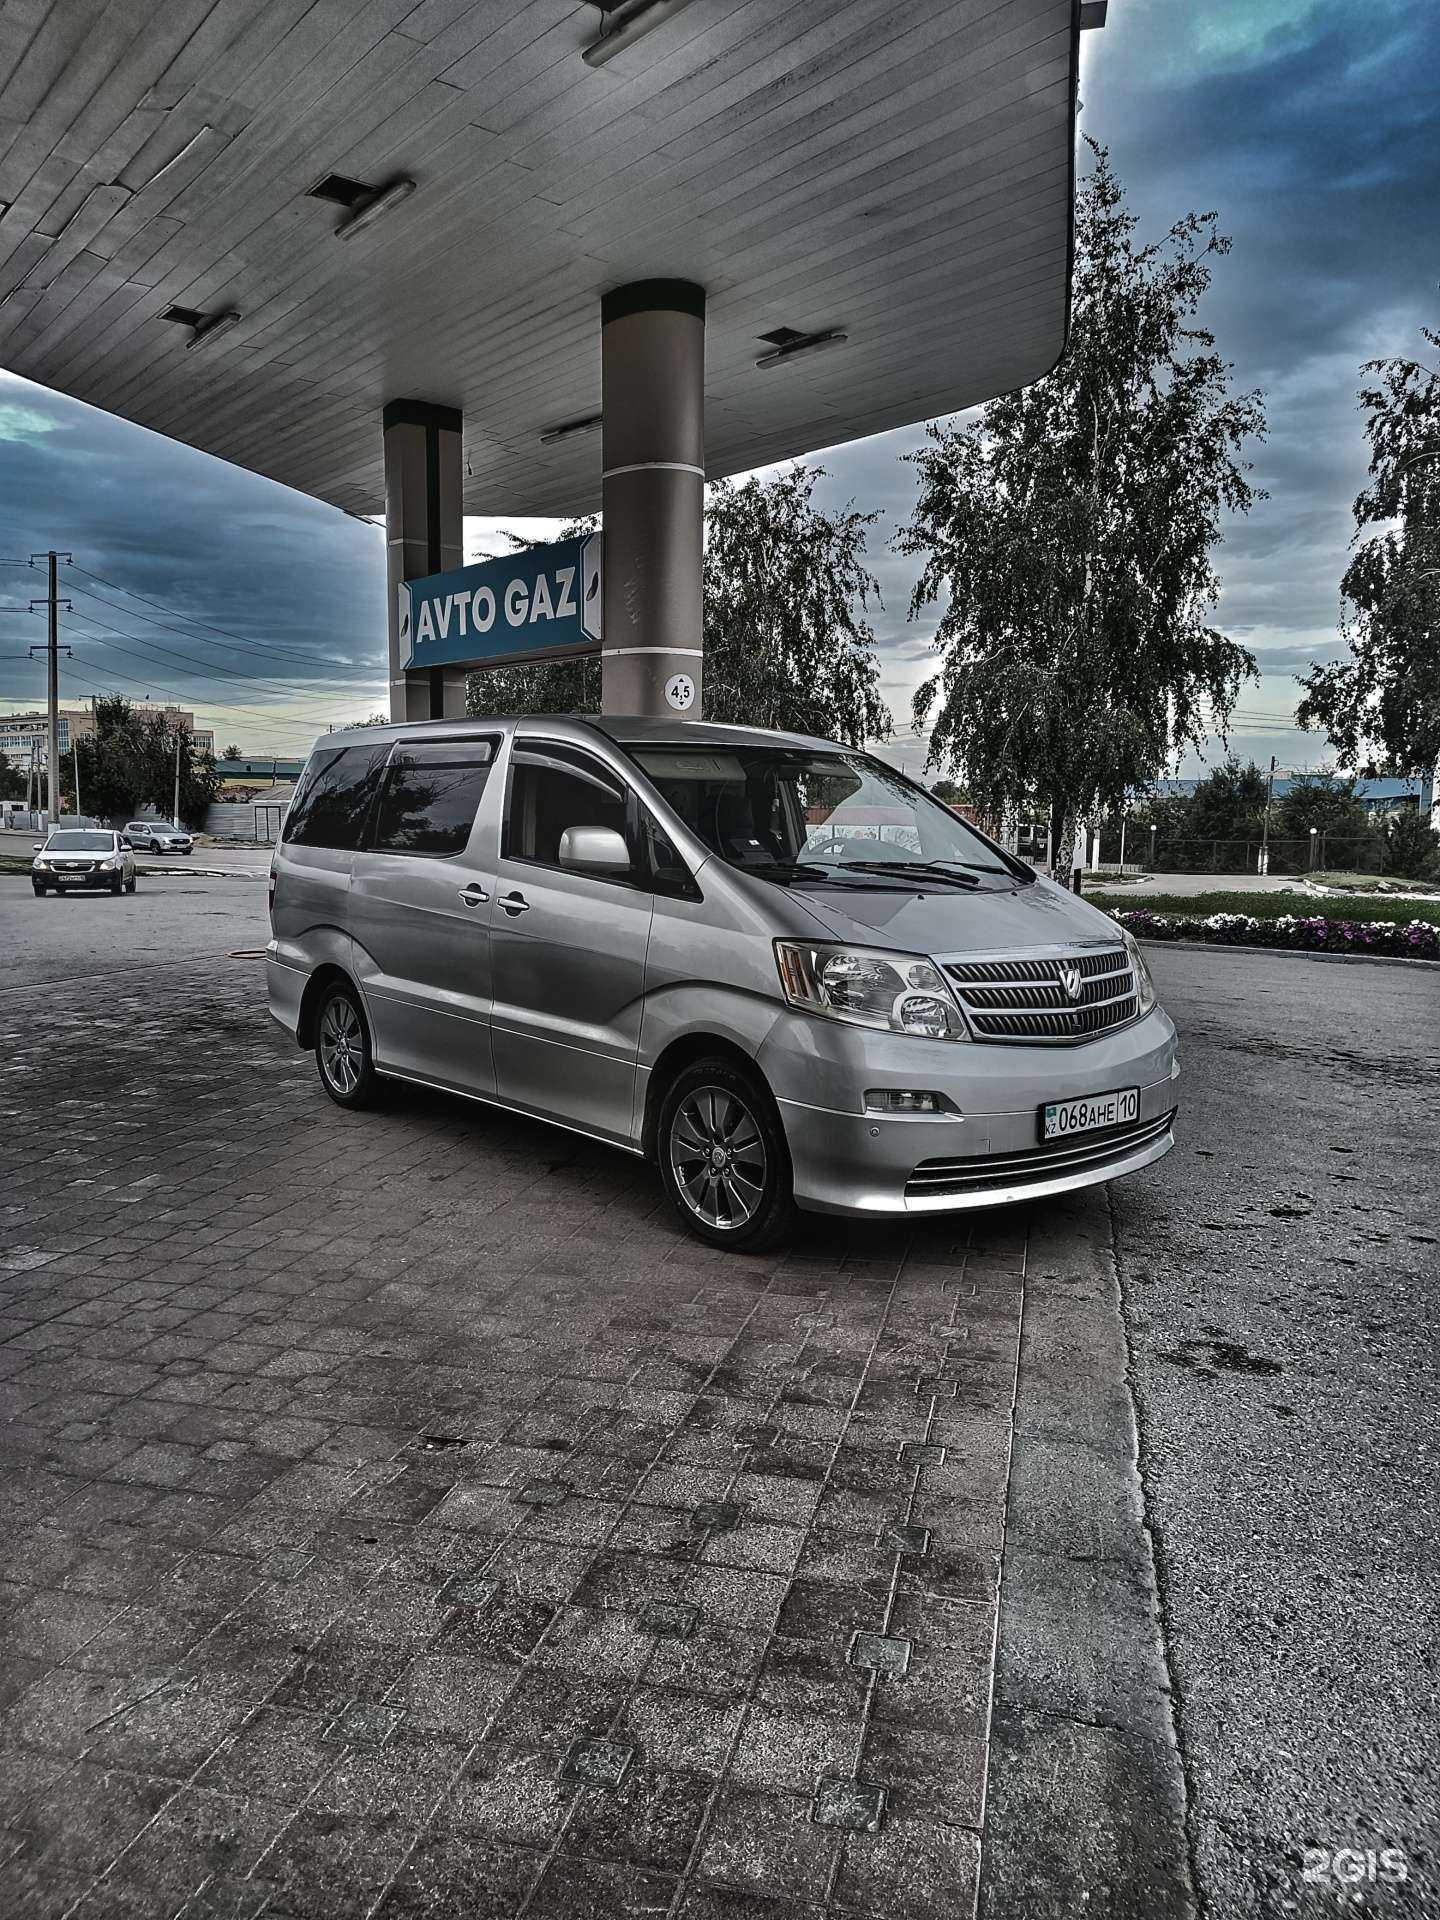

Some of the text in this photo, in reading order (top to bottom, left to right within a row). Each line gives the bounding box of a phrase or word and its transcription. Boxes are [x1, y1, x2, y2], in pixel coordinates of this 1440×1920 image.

[417, 566, 577, 643] AVTO GAZ
[671, 685, 690, 700] 4,5
[1059, 1093, 1136, 1131] 068AHE 10
[1045, 1123, 1056, 1135] KZ
